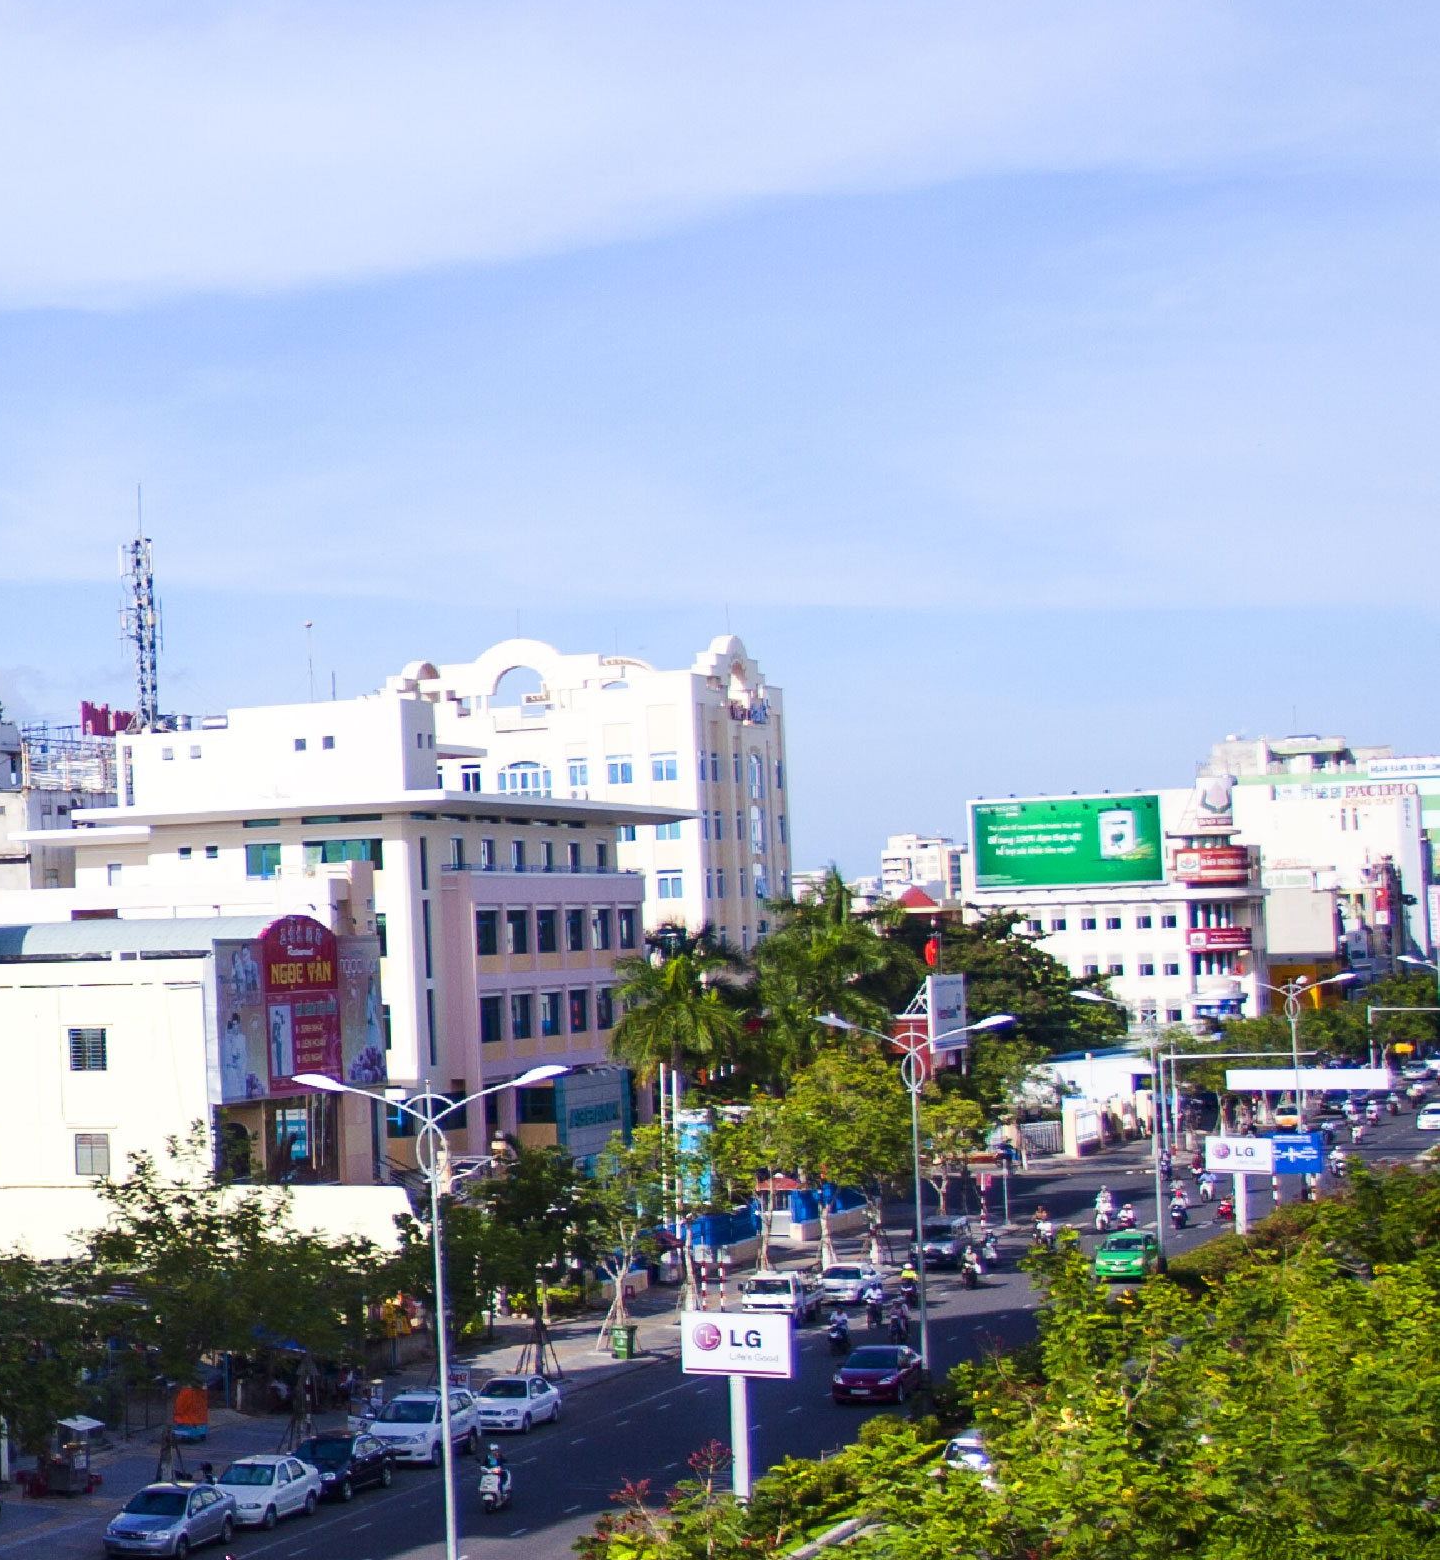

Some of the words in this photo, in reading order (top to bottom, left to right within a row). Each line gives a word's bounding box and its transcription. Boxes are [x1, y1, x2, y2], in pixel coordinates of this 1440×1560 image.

[270, 962, 304, 990] NGỌC
[307, 955, 332, 983] VÂN
[1235, 1147, 1254, 1157] LG
[730, 1328, 762, 1349] LG
